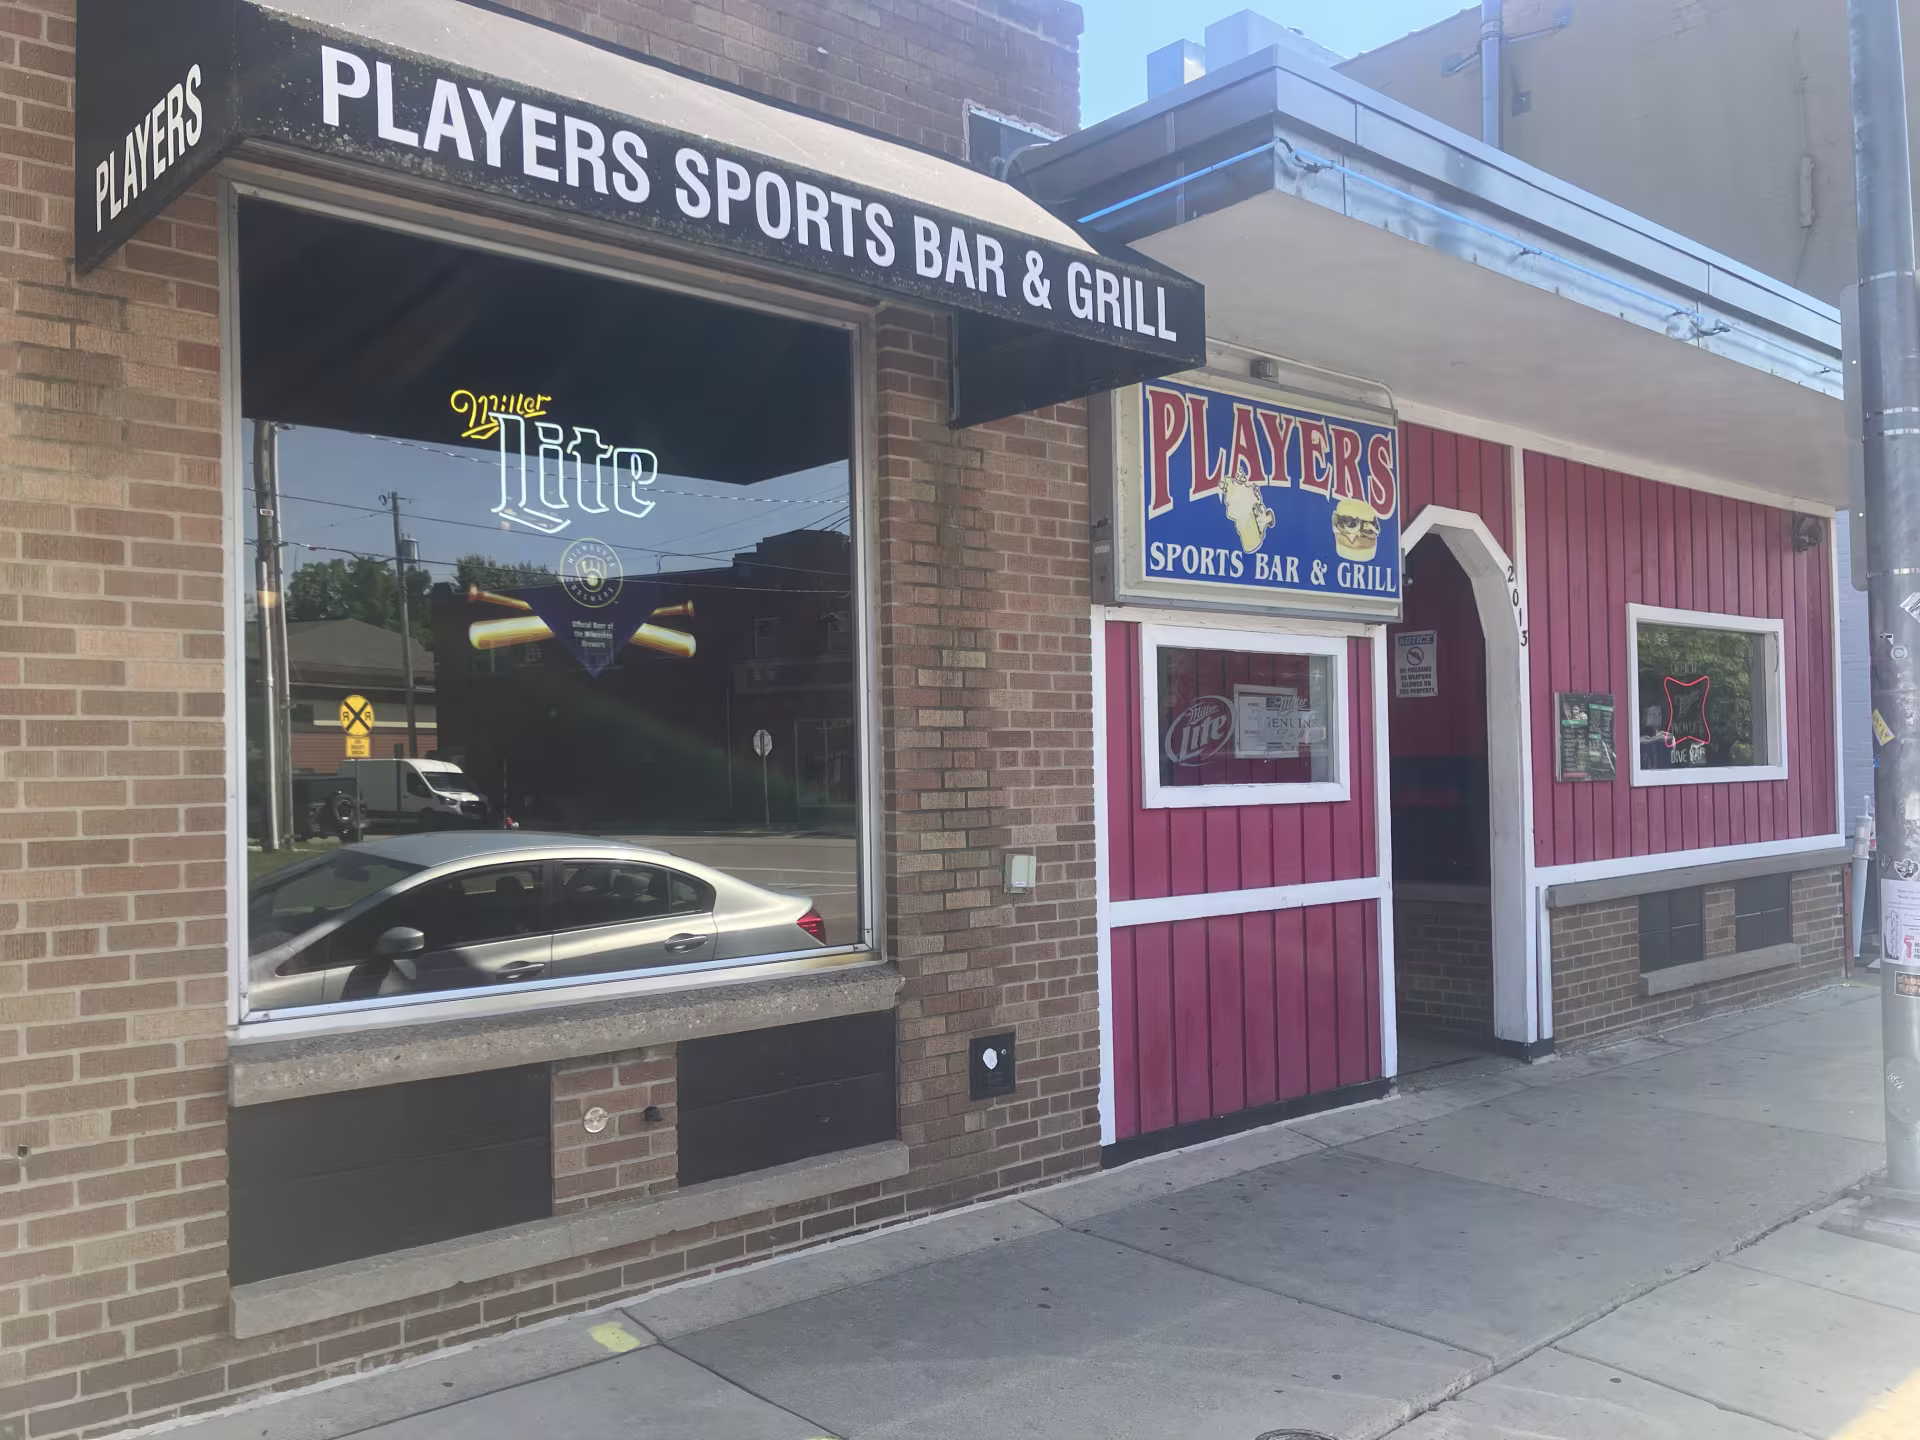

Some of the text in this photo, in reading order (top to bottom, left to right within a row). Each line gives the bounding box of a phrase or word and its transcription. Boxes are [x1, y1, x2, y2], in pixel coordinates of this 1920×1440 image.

[95, 63, 203, 233] PLAYERS
[321, 45, 1177, 342] PLAYERS SPORTS BAR & GRILL
[450, 389, 552, 439] Miller
[1145, 385, 1396, 520] PLAYERS
[1149, 541, 1397, 593] SPORTS BAR & GRILL
[1507, 565, 1528, 647] 2013
[1399, 635, 1432, 646] NOTICE
[1185, 705, 1218, 724] Miller
